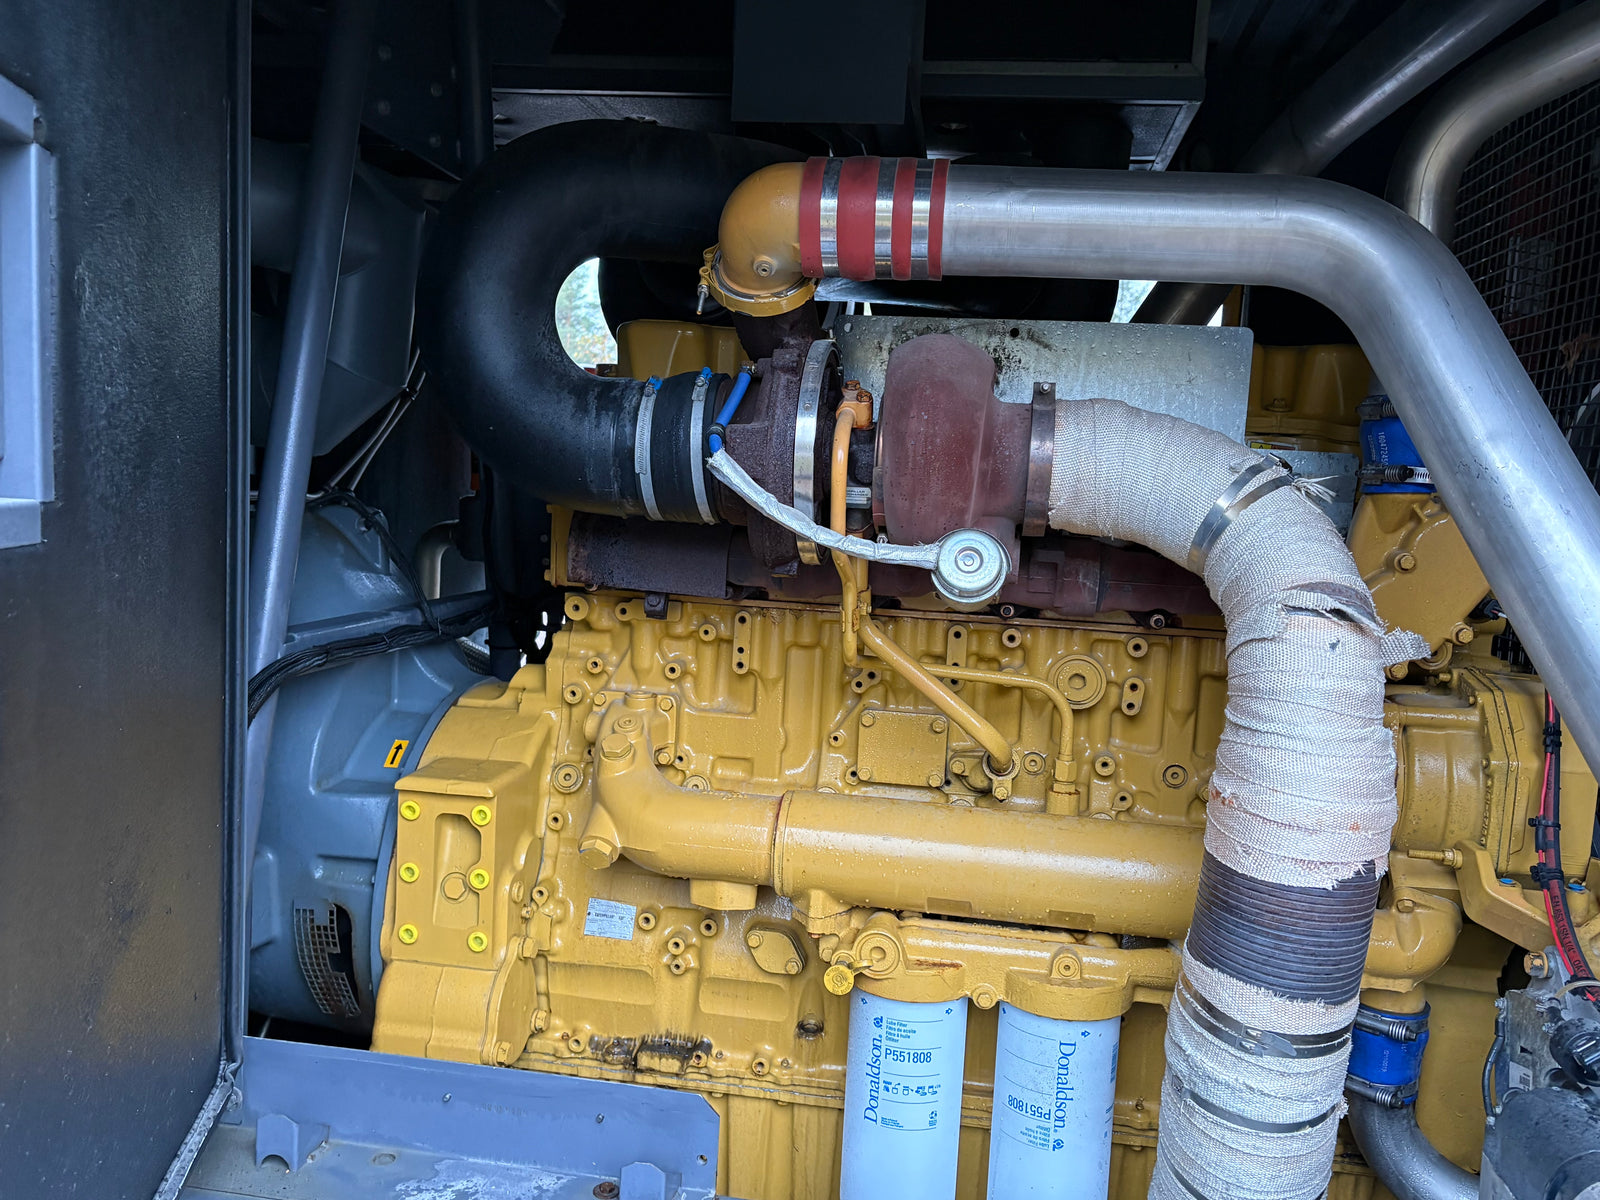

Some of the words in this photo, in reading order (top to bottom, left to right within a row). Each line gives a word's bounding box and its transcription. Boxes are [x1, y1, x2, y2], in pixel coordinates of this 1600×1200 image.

[884, 1047, 932, 1064] P551808
[1053, 1040, 1077, 1129] Donaldson
[1007, 1094, 1052, 1121] P551808
